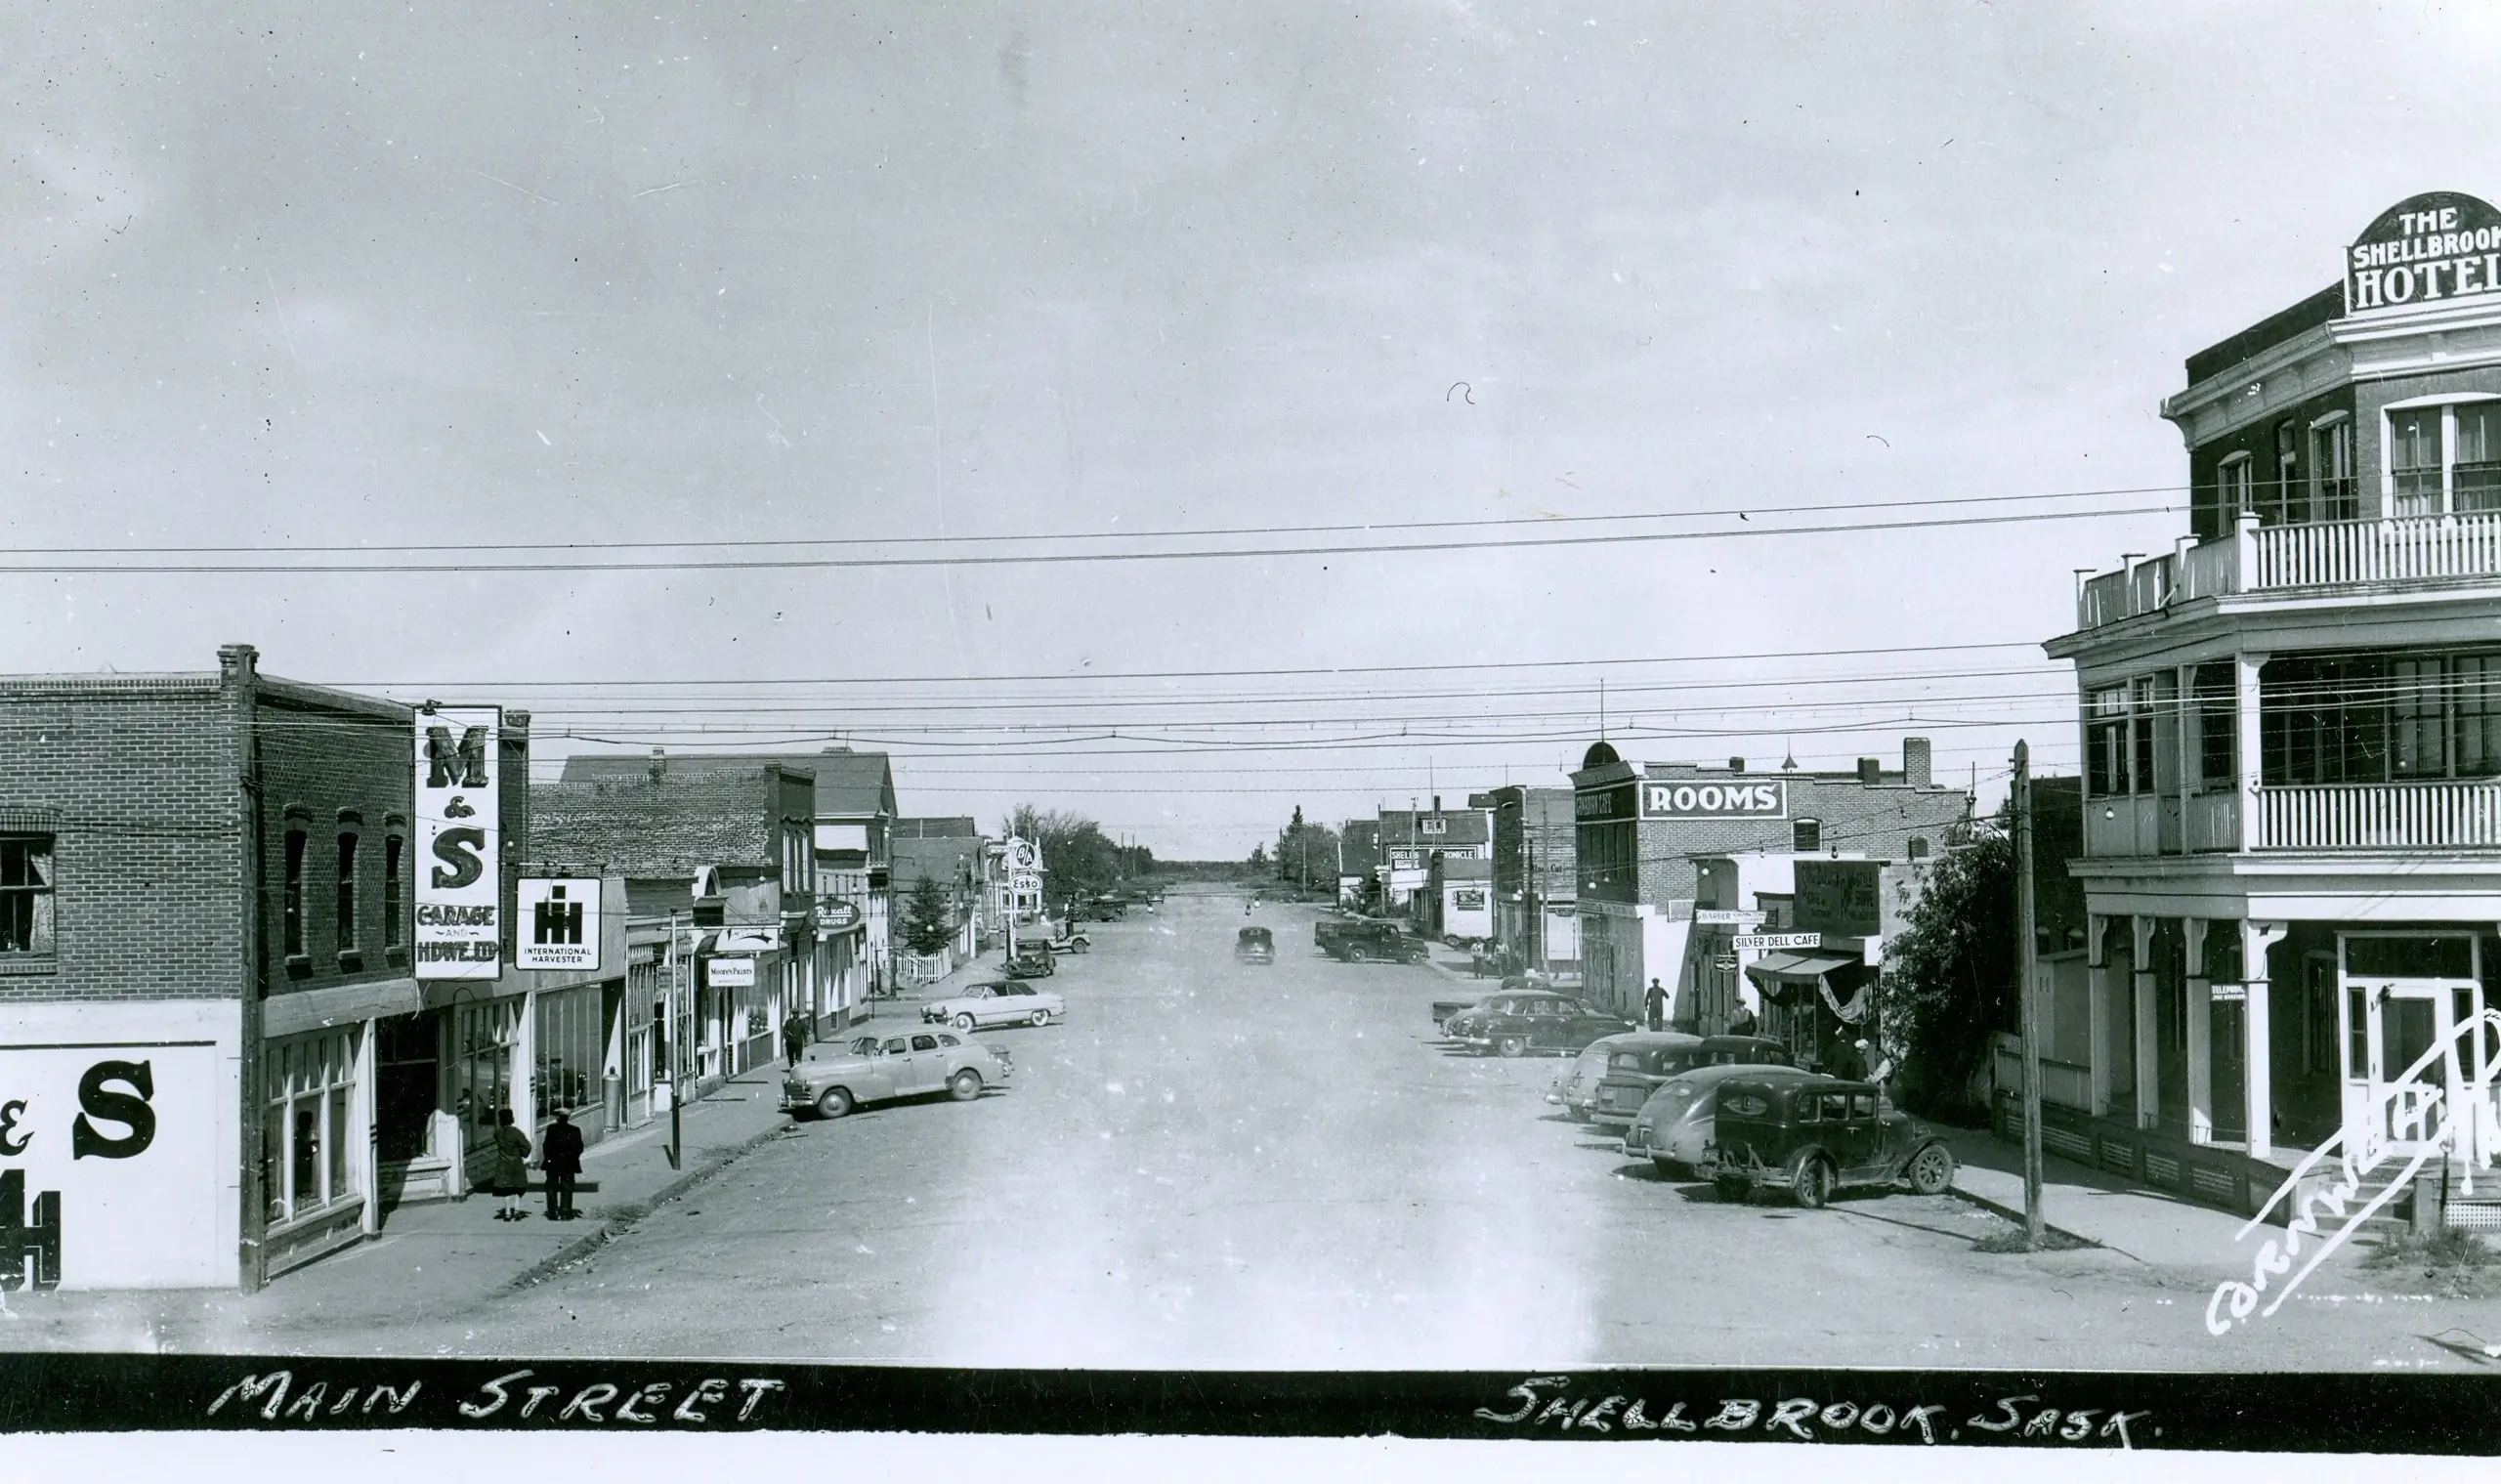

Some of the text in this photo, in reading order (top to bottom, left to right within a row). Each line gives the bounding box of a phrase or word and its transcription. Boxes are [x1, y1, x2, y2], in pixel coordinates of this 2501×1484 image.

[2399, 207, 2458, 234] THE
[426, 726, 488, 889] M & S
[1649, 784, 1777, 811] ROOMS
[417, 906, 495, 926] GARAGE
[1735, 934, 1819, 948] SILVER DELL CAFE
[72, 1060, 156, 1161] S
